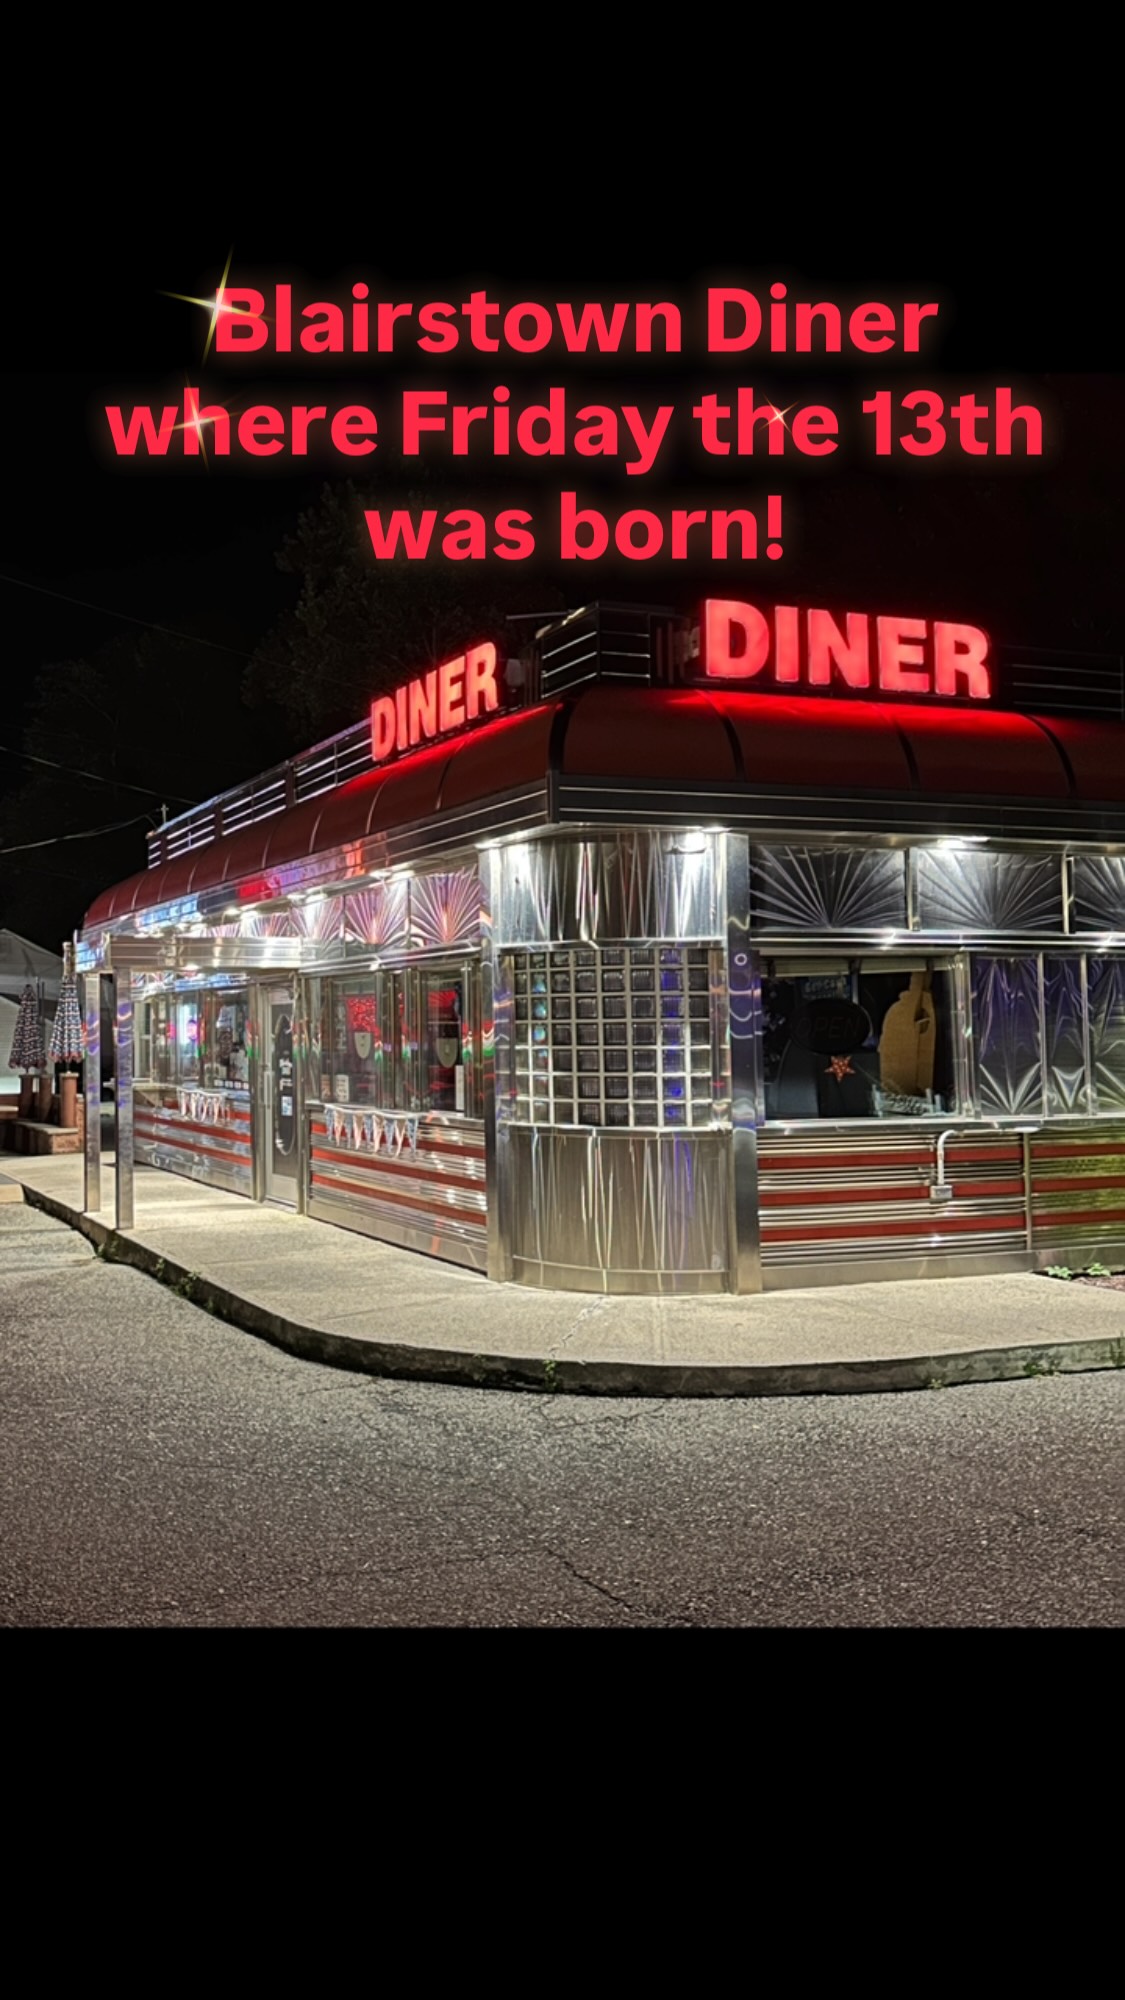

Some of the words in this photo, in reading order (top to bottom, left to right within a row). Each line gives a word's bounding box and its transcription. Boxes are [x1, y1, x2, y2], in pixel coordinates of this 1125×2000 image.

[705, 598, 991, 699] DINER
[371, 641, 498, 762] DINER
[796, 1015, 861, 1039] OPEN
